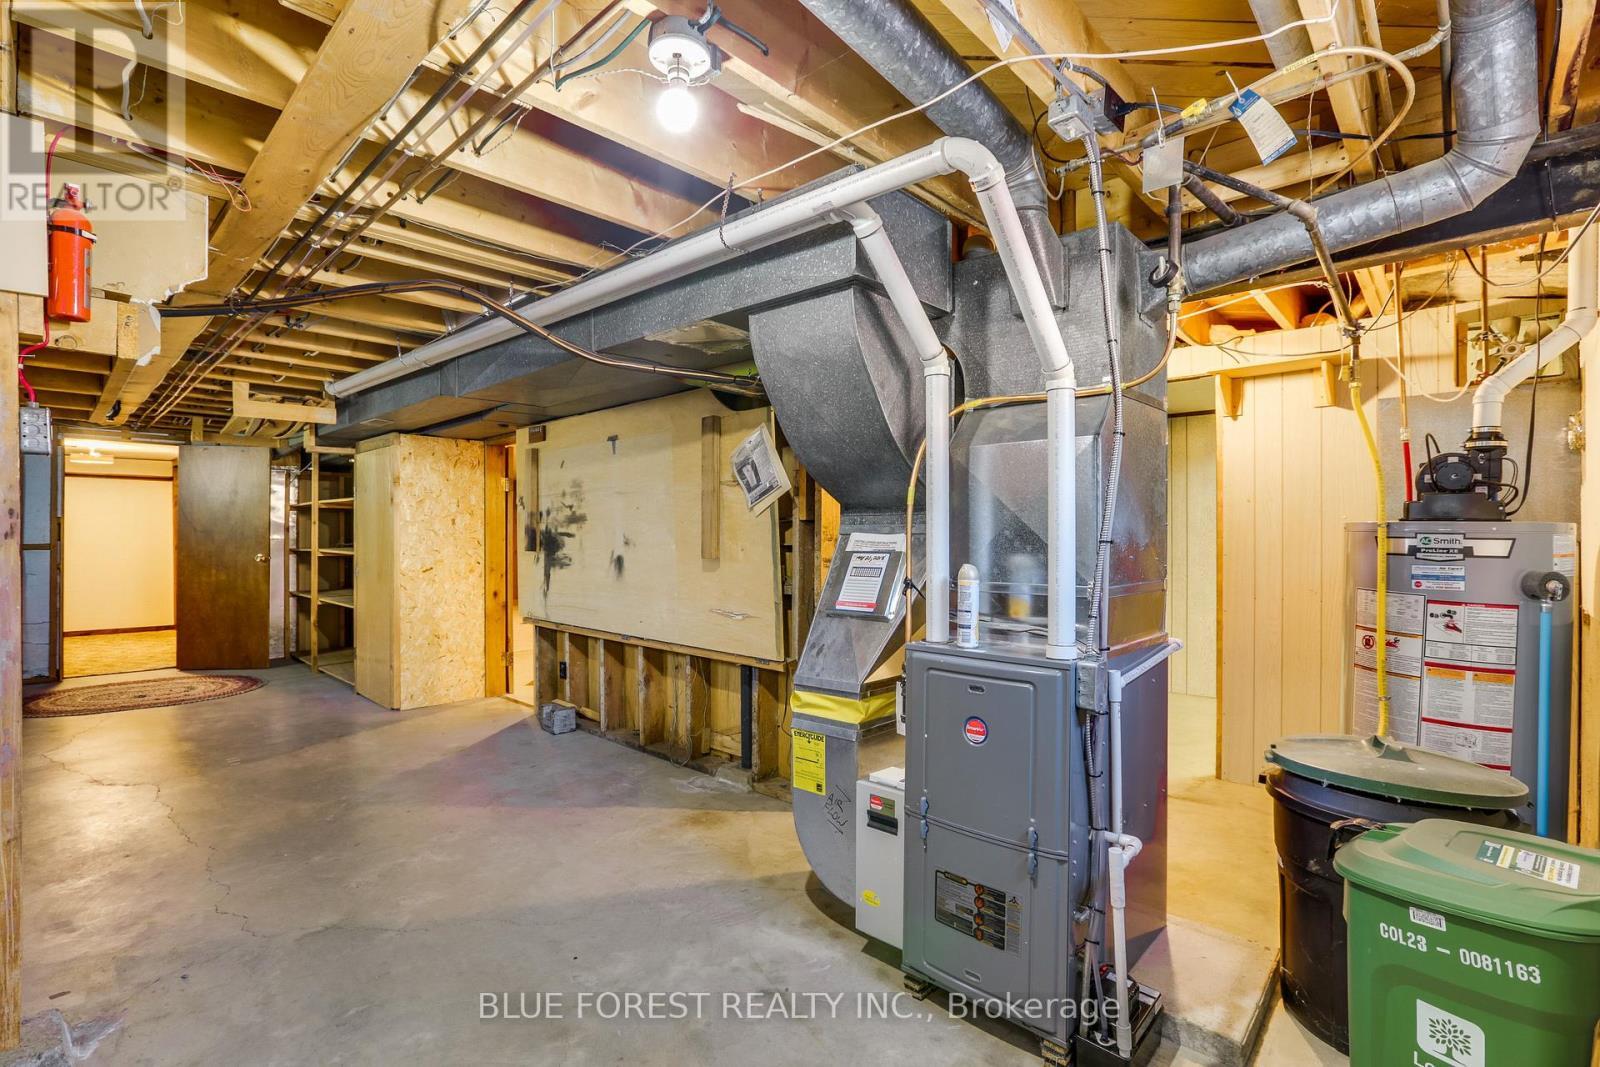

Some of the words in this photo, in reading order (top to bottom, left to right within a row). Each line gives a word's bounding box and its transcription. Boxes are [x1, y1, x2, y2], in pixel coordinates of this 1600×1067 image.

[1433, 537, 1461, 545] Smith
[1379, 922, 1427, 952] COL23
[1459, 948, 1541, 984] 0081163
